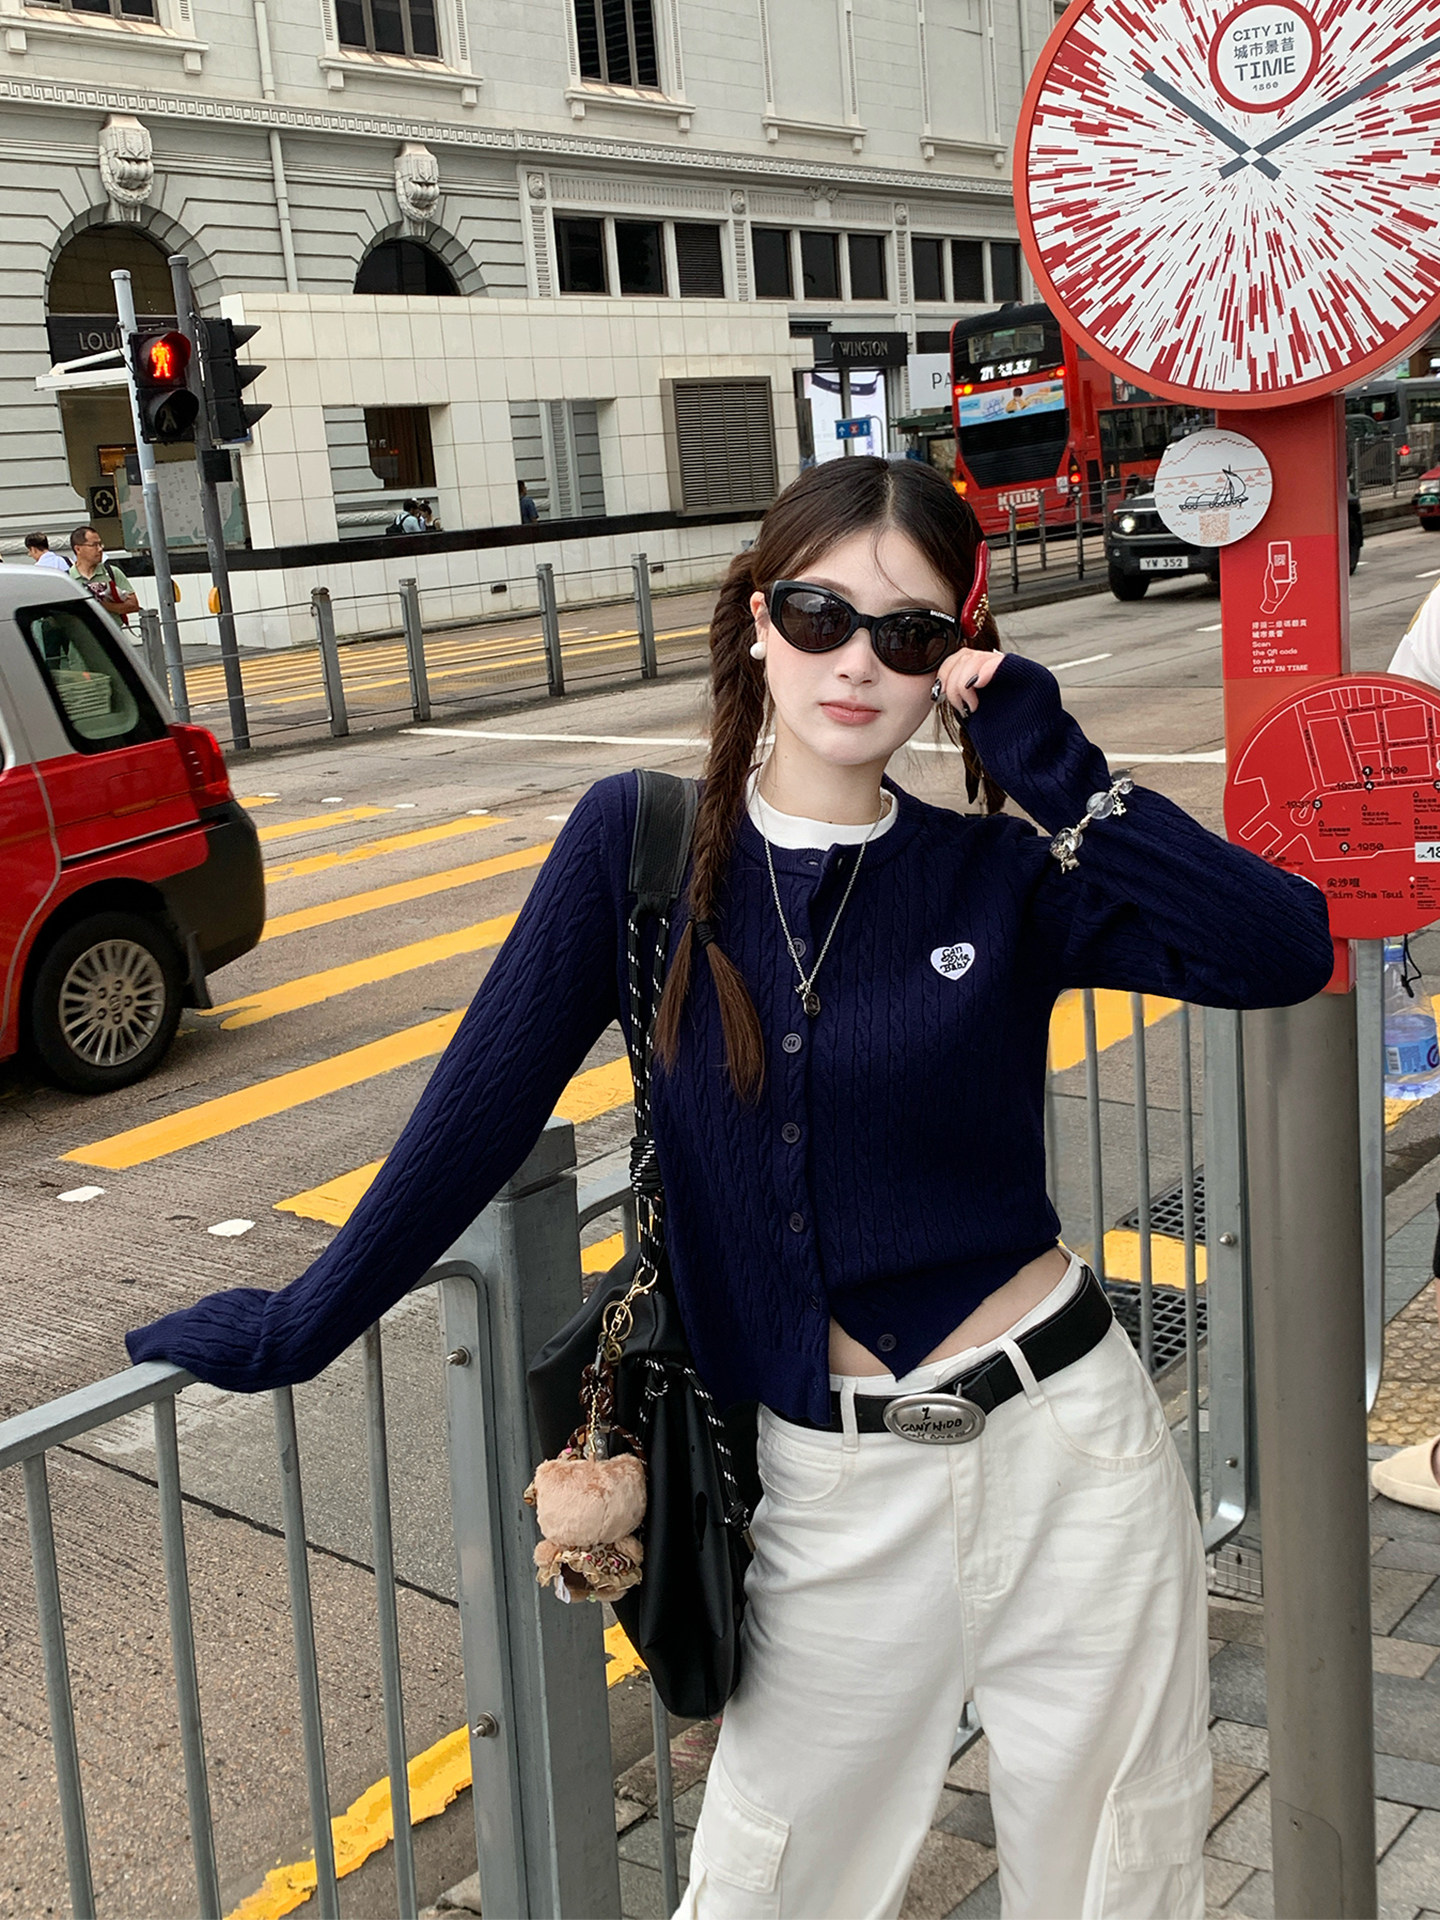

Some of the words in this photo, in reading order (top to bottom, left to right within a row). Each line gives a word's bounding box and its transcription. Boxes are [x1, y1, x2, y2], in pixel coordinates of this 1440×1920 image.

[1232, 24, 1271, 42] CITY
[1275, 21, 1295, 34] IN
[1233, 37, 1296, 60] 城市景昔
[1234, 55, 1296, 81] TIME
[79, 332, 121, 350] LOUI
[839, 341, 889, 357] WINSTON
[1163, 558, 1183, 568] 352
[1267, 648, 1278, 656] QR
[1356, 890, 1377, 899] Sha
[1380, 890, 1404, 899] Tsui
